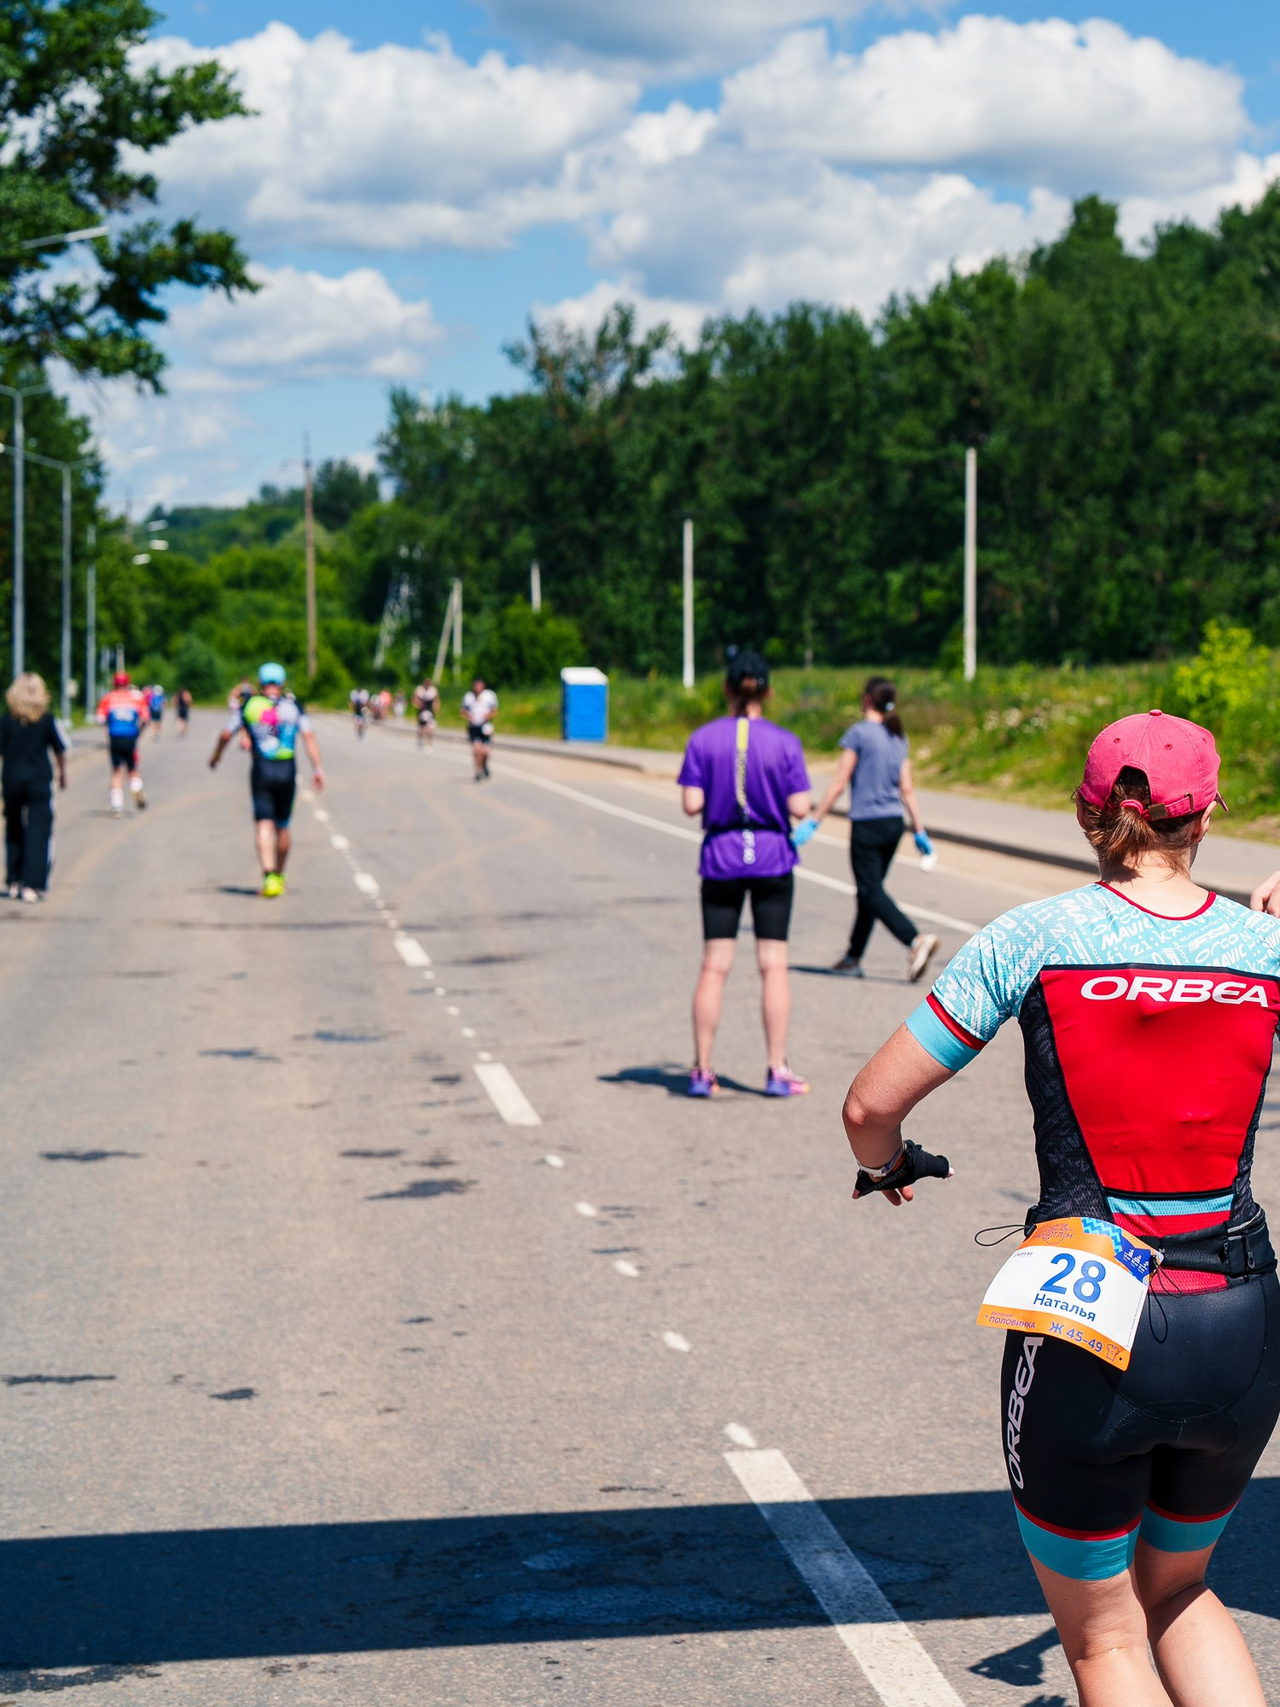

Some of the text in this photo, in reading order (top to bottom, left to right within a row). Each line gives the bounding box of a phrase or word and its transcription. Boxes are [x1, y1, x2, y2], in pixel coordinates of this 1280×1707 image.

[1080, 976, 1269, 1008] ORBEA
[1039, 1252, 1107, 1304] 28
[988, 1316, 1036, 1329] ПОЛОВИНКА
[1032, 1293, 1097, 1323] Наталья
[1048, 1321, 1104, 1353] Ж 45-49
[1006, 1336, 1044, 1490] ORBEA
